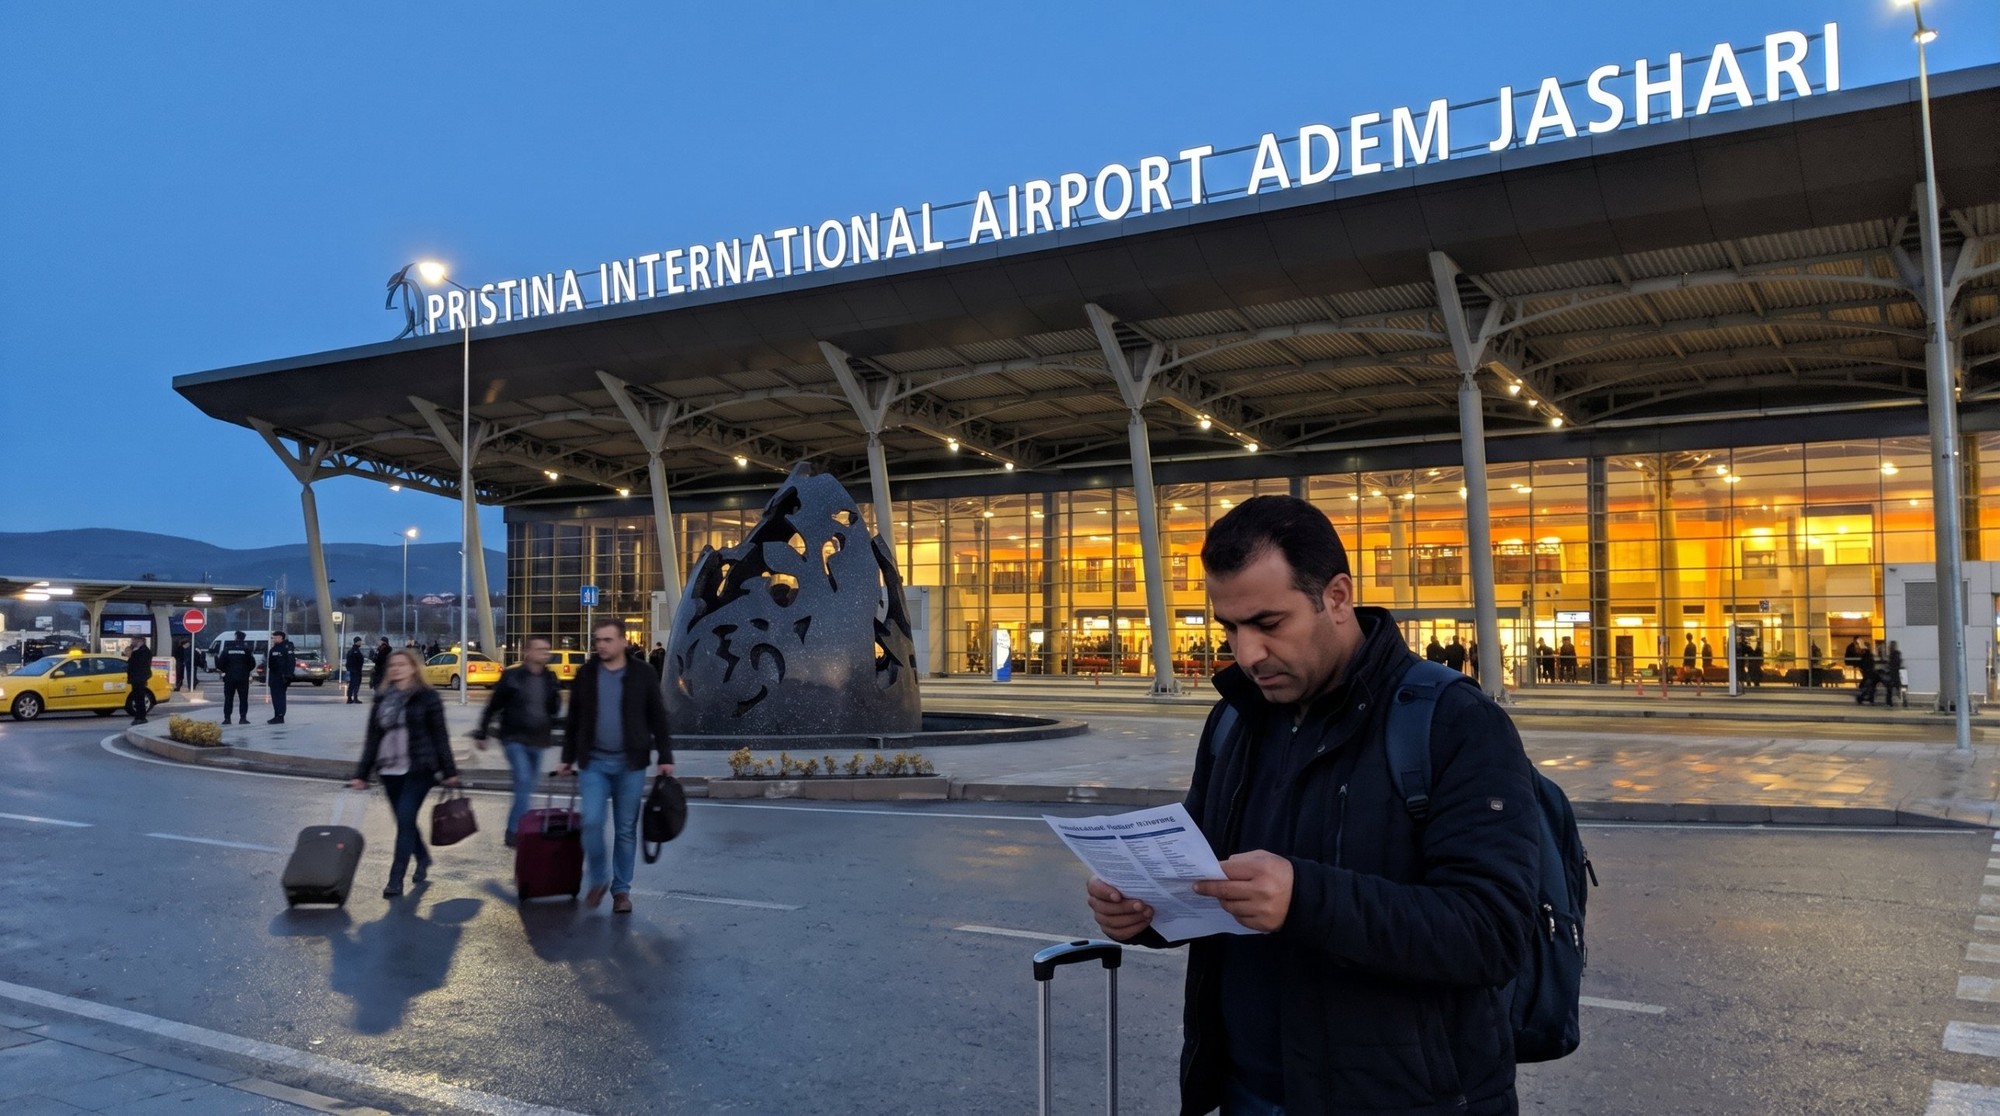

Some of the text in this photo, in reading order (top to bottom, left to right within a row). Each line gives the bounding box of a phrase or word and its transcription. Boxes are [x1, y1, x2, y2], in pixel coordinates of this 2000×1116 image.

[428, 21, 1840, 334] PRISTINA INTERNATIONAL AIRPORT ADEM JASHARI
